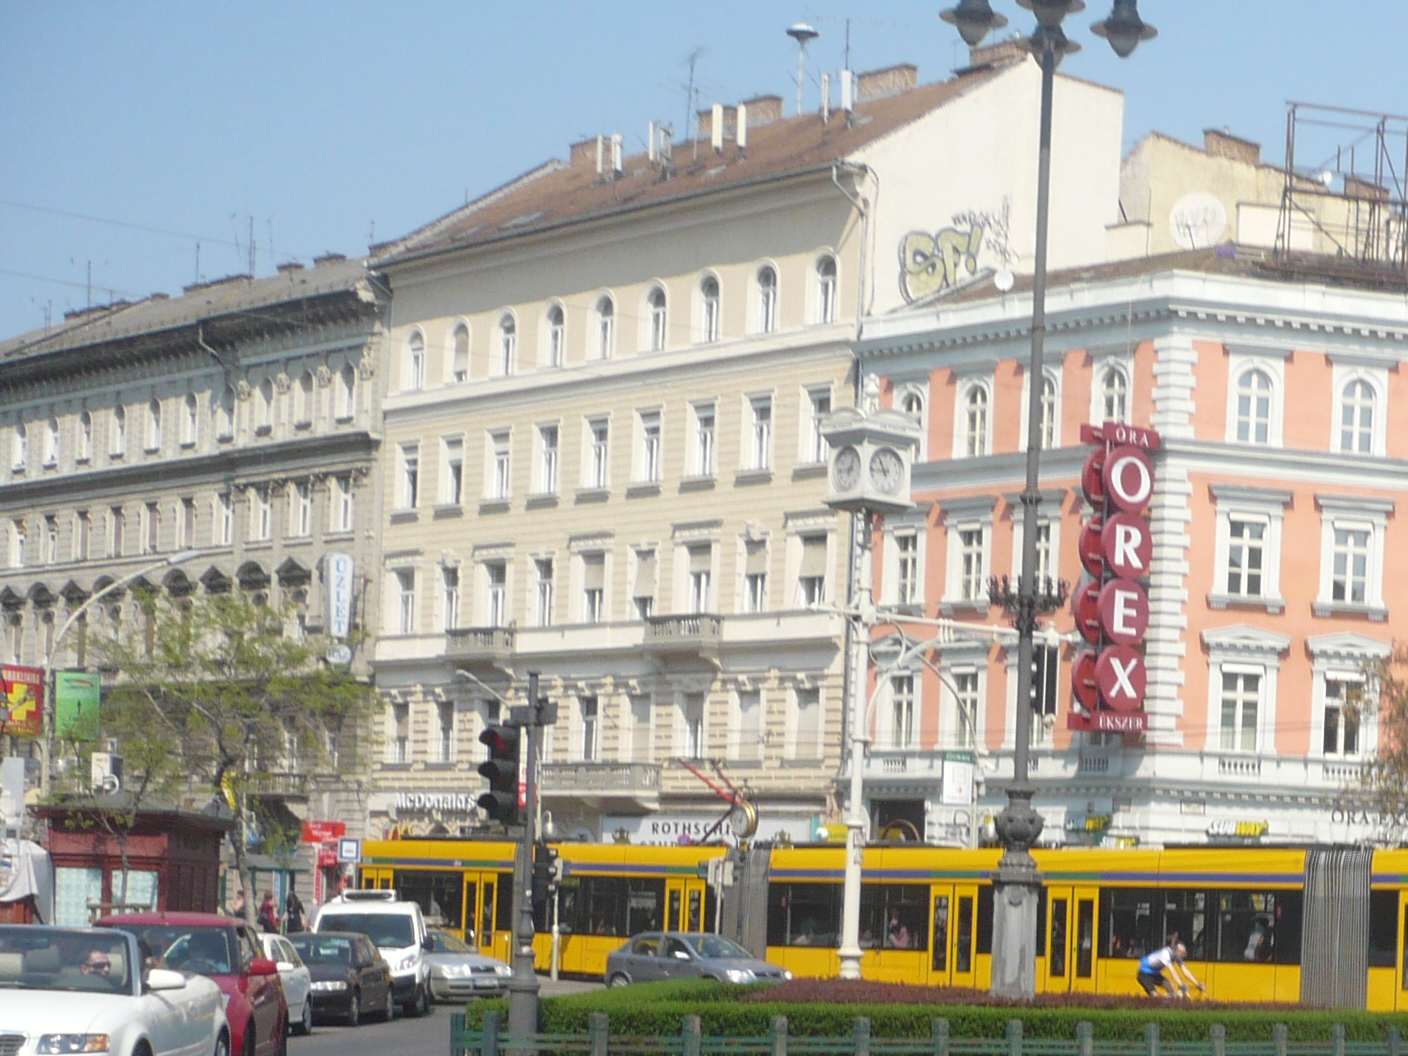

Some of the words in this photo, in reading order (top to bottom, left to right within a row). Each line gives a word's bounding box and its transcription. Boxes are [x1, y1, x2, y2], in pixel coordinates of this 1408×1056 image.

[1115, 424, 1150, 449] ÓRA
[1108, 456, 1151, 699] OREX
[395, 790, 475, 812] McDonald's
[1208, 819, 1269, 837] SUBWAY
